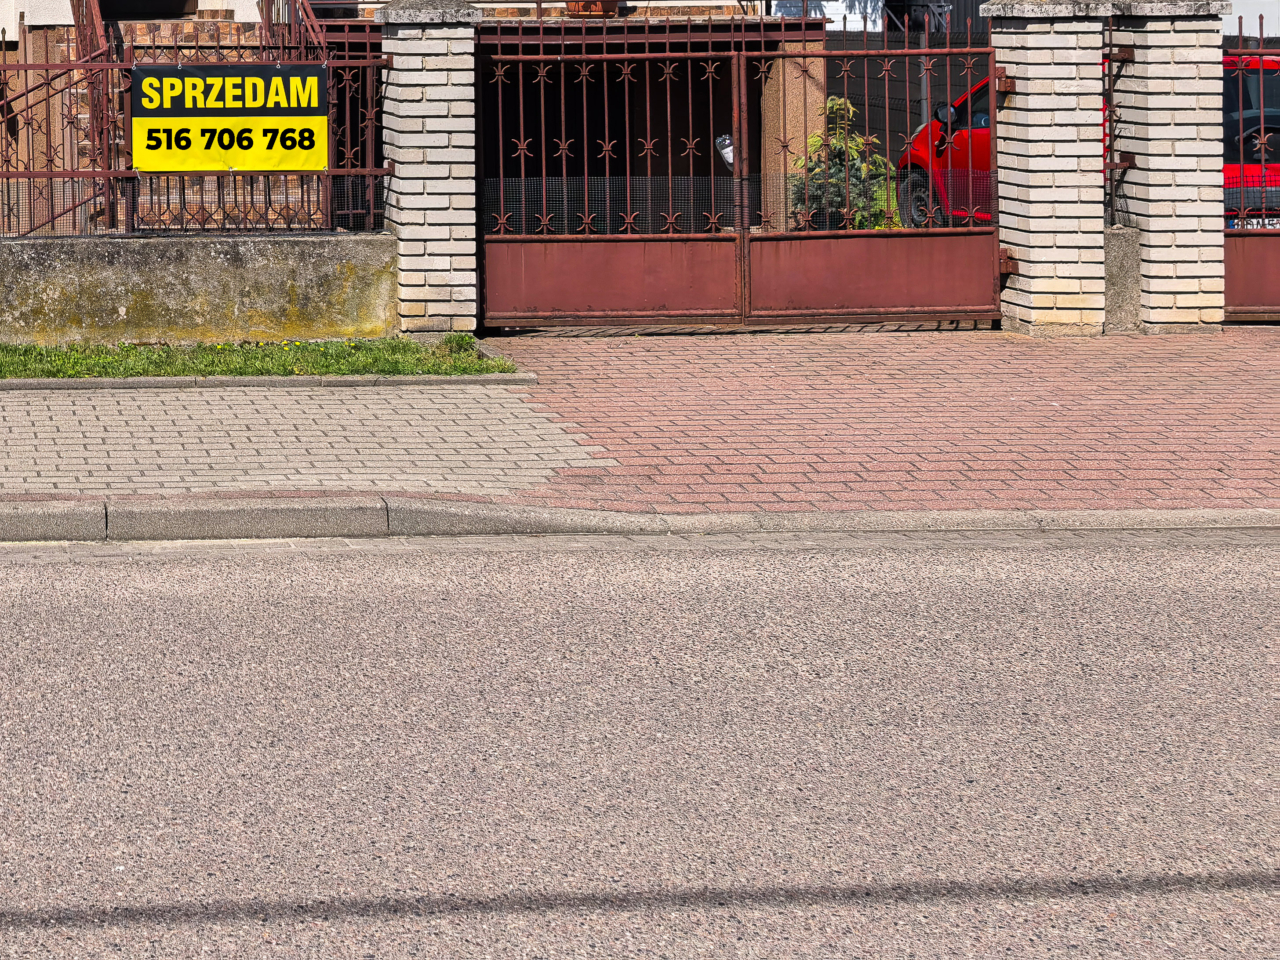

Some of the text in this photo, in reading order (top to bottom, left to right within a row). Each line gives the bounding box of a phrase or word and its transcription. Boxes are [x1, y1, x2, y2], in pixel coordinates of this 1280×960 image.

[141, 76, 319, 110] SPRZEDAM
[145, 128, 316, 151] 516 706 768
